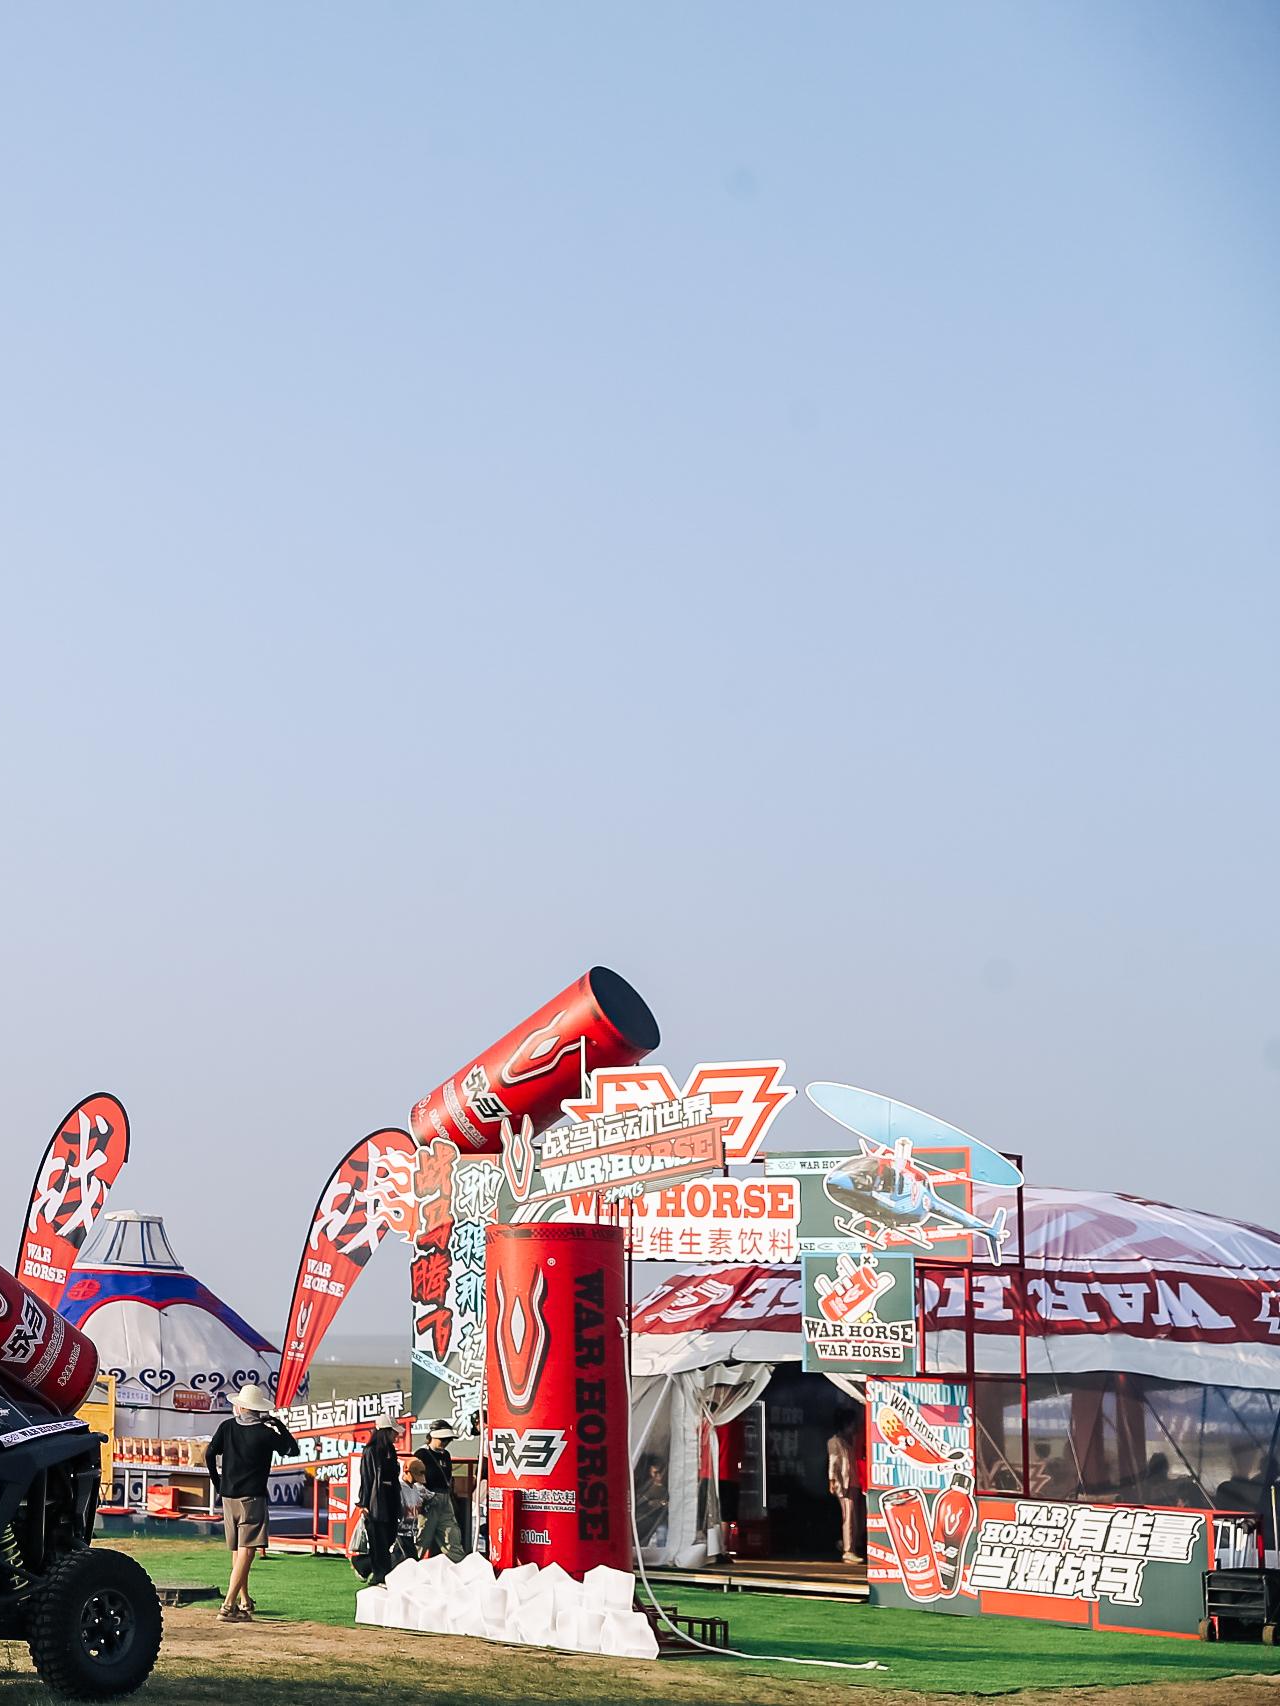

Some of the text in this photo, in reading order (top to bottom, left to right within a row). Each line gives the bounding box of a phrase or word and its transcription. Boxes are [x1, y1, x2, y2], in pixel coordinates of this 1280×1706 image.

[542, 1092, 712, 1160] 战马运动世界
[541, 1131, 714, 1195] WAR HORSE
[800, 1161, 821, 1169] WAR
[604, 1181, 646, 1203] SPORTS
[656, 1184, 794, 1219] HORSE
[27, 1242, 52, 1262] WAR
[23, 1259, 67, 1284] HORSE
[307, 1258, 332, 1278] WAR
[302, 1274, 346, 1297] HORSE
[1027, 1278, 1236, 1331] WAR
[573, 1267, 607, 1370] WAR
[805, 1319, 913, 1344] WAR HORSE
[818, 1344, 901, 1359] WAR HORSE
[907, 1382, 951, 1405] WORLD
[890, 1392, 949, 1456] WAR HORSE
[490, 1430, 564, 1476] 战马
[574, 1378, 610, 1541] HORSE
[316, 1462, 348, 1481] SPORTS
[1017, 1503, 1068, 1528] WAR
[980, 1521, 1065, 1549] HORSE
[1067, 1507, 1202, 1560] 有能量
[969, 1545, 1146, 1604] 当燃战马
